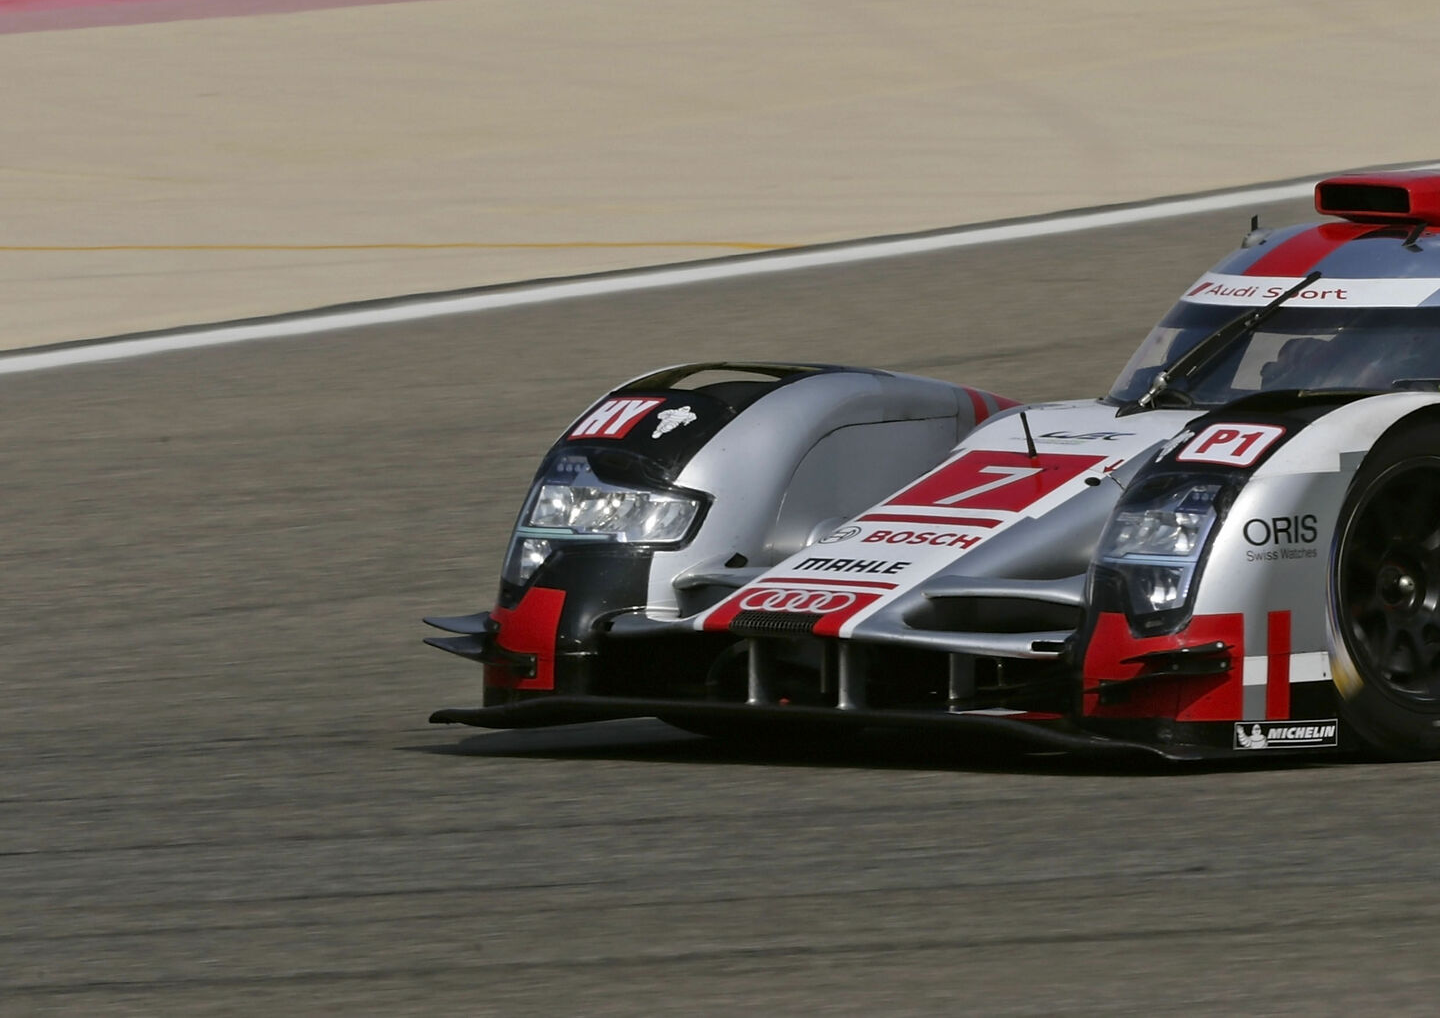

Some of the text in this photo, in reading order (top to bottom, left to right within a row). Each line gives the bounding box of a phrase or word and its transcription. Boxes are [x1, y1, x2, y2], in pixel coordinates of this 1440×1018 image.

[1205, 284, 1260, 298] Audi
[570, 399, 661, 437] HY
[1194, 429, 1266, 457] P1
[932, 465, 1045, 505] 7
[861, 530, 983, 550] BOSCH
[1243, 514, 1318, 546] ORIS
[1246, 548, 1318, 562] Swiss Watches
[792, 557, 913, 575] MAHLE
[1267, 725, 1336, 739] MICHELIN
